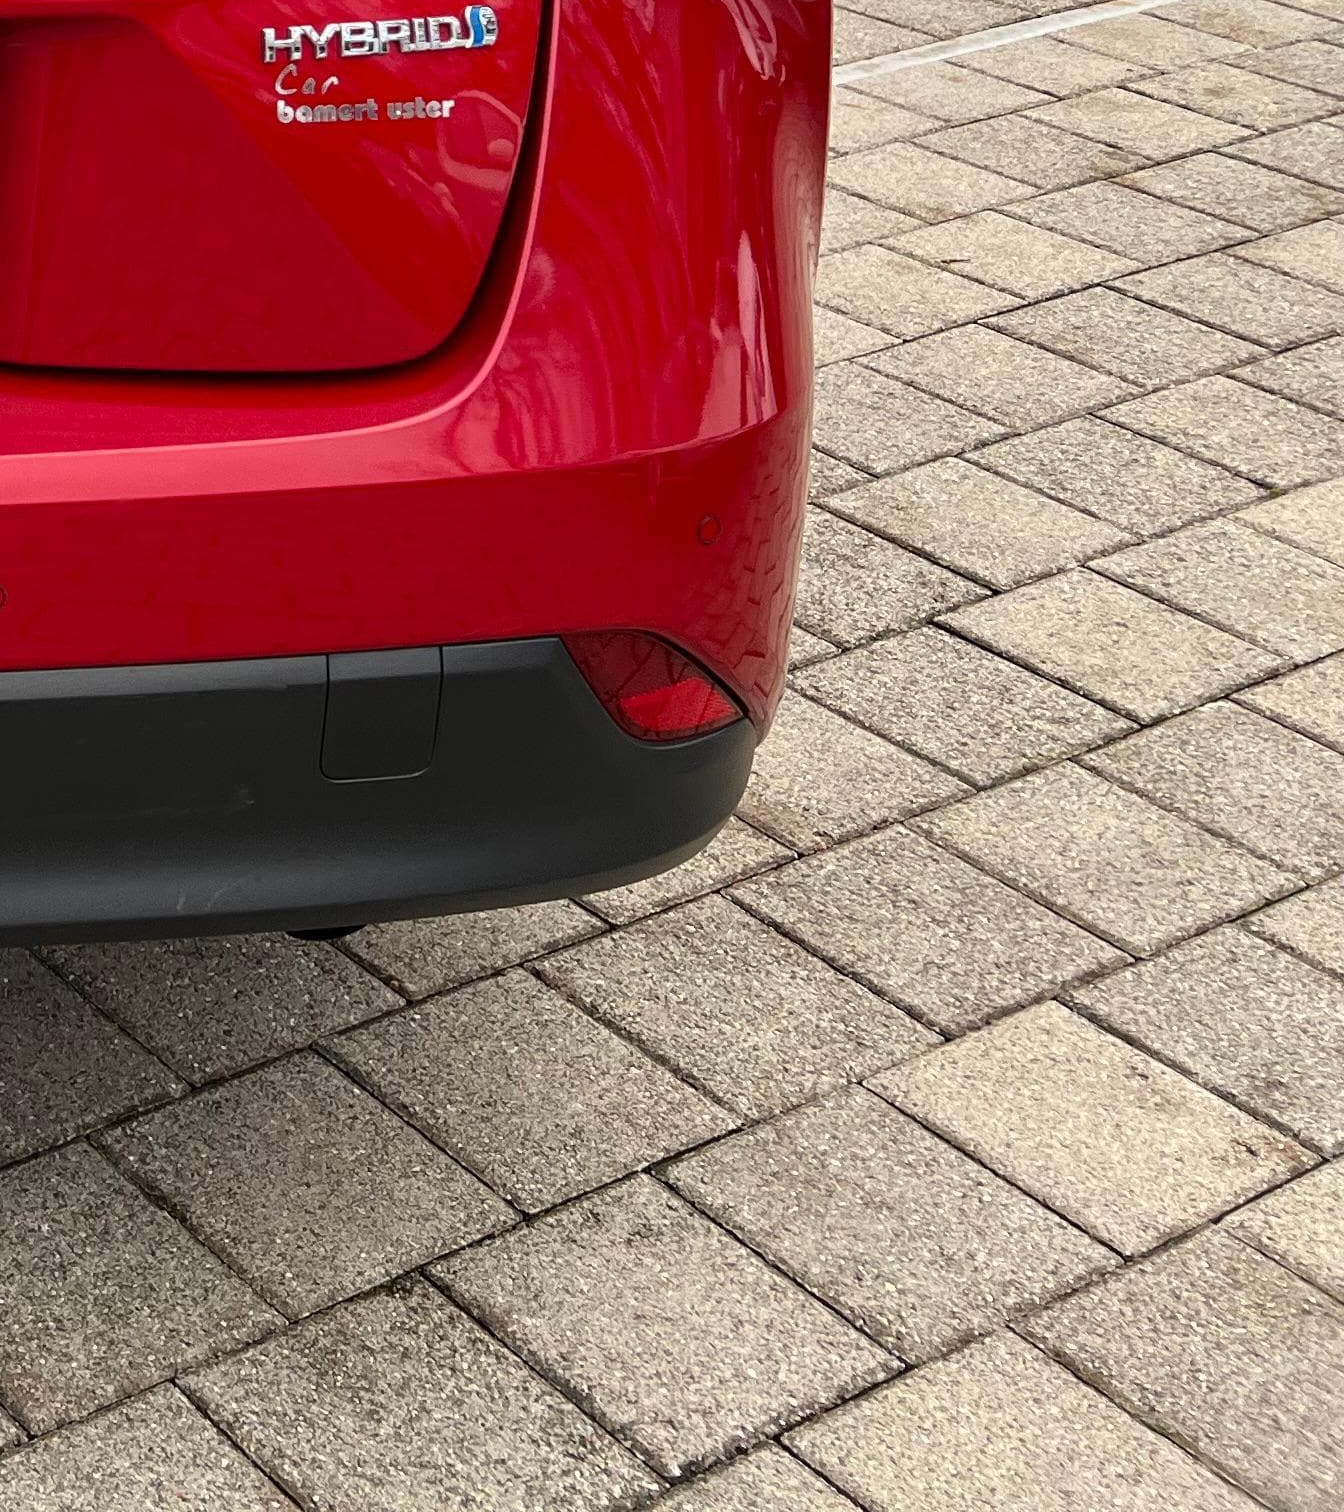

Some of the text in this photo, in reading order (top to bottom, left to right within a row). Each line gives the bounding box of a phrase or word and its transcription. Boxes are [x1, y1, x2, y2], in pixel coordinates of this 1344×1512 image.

[262, 15, 465, 64] HYBRID
[274, 63, 340, 95] Car
[276, 96, 456, 124] bamert uster
